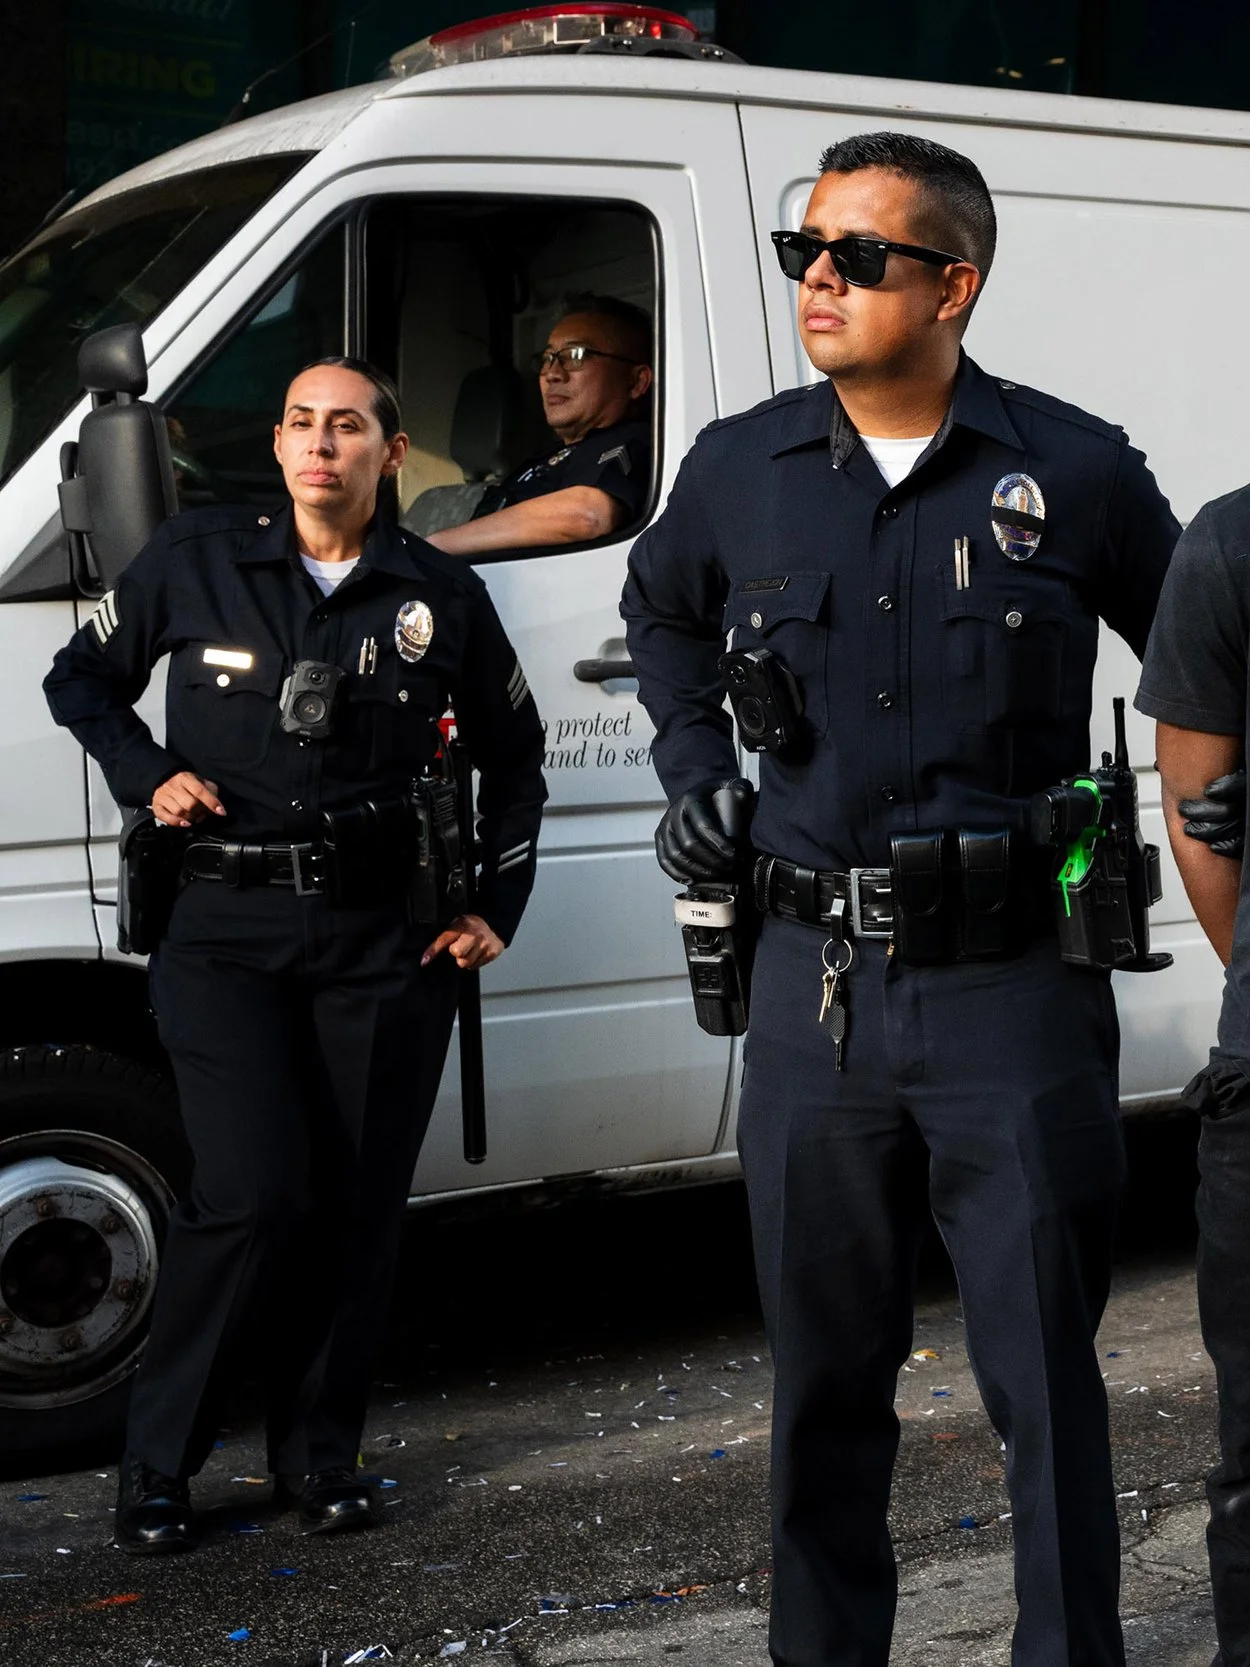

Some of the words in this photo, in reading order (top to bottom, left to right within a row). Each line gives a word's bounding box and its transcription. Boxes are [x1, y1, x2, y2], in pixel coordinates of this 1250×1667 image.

[68, 40, 217, 98] IRING
[556, 712, 632, 744] protect
[543, 741, 588, 769] and
[596, 743, 616, 768] to
[623, 746, 652, 767] ser
